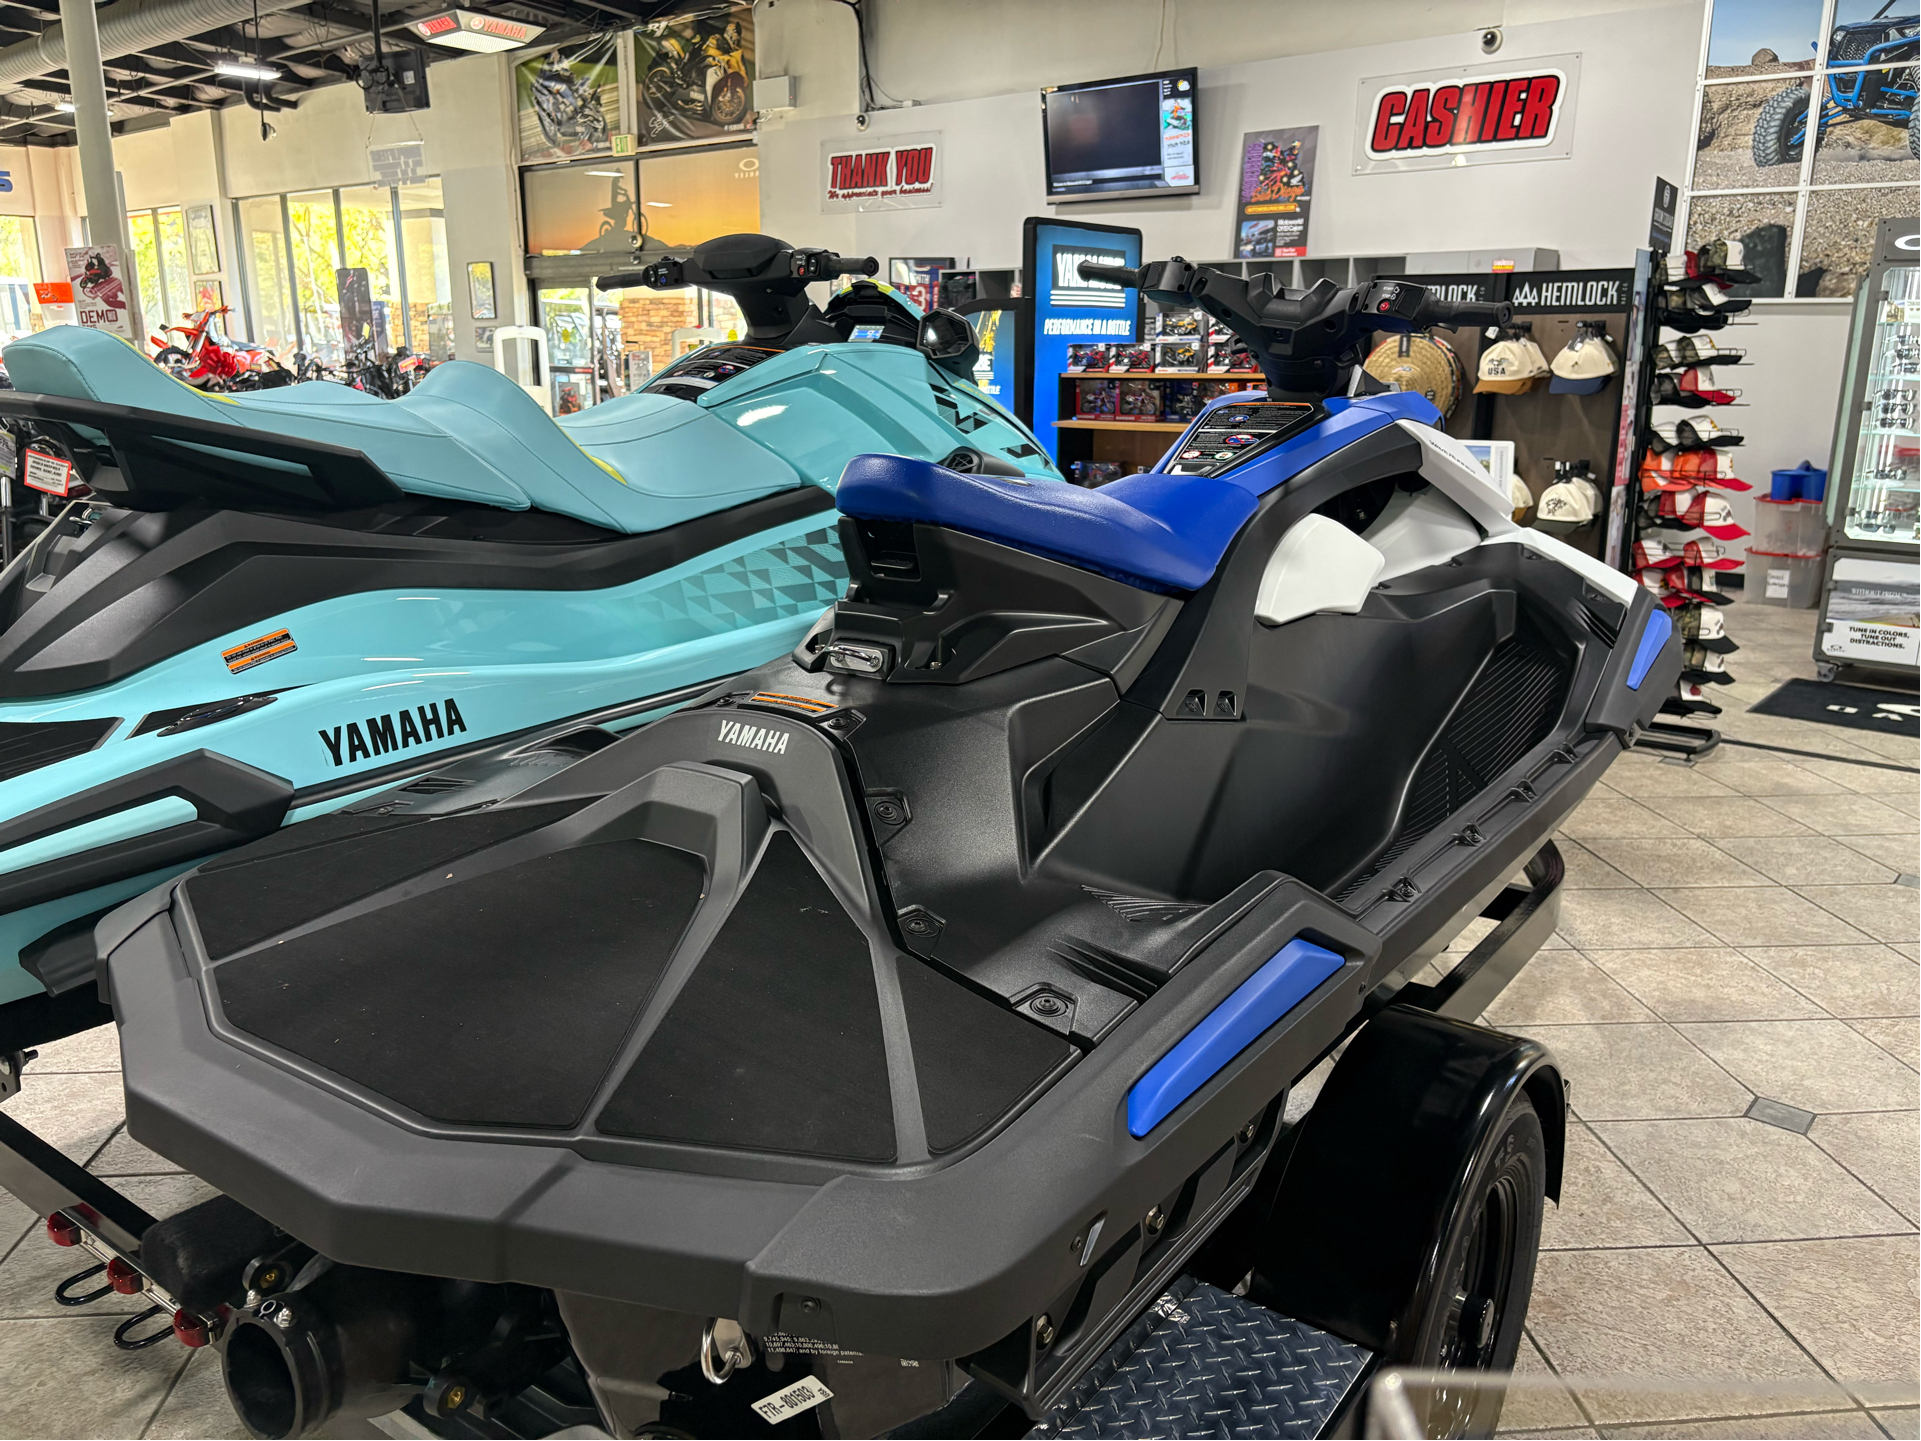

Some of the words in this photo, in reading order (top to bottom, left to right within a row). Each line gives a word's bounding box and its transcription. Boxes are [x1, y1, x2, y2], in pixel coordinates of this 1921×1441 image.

[483, 19, 527, 39] YAMAHA
[1371, 75, 1560, 153] CASHIER
[615, 136, 629, 153] EXIT
[831, 151, 890, 190] THANK
[895, 147, 933, 186] YOU
[1540, 281, 1620, 306] HEMLOCK
[80, 309, 119, 324] DEMO
[1044, 318, 1093, 335] PERFORMANCE
[1107, 319, 1131, 336] BOTTLE
[1487, 367, 1506, 376] USA
[1849, 638, 1905, 649] DISTRACTIONS.
[1878, 630, 1910, 639] COLORS,
[318, 698, 467, 767] YAMAHA
[717, 720, 790, 754] YAMAHA
[817, 1387, 831, 1399] USA
